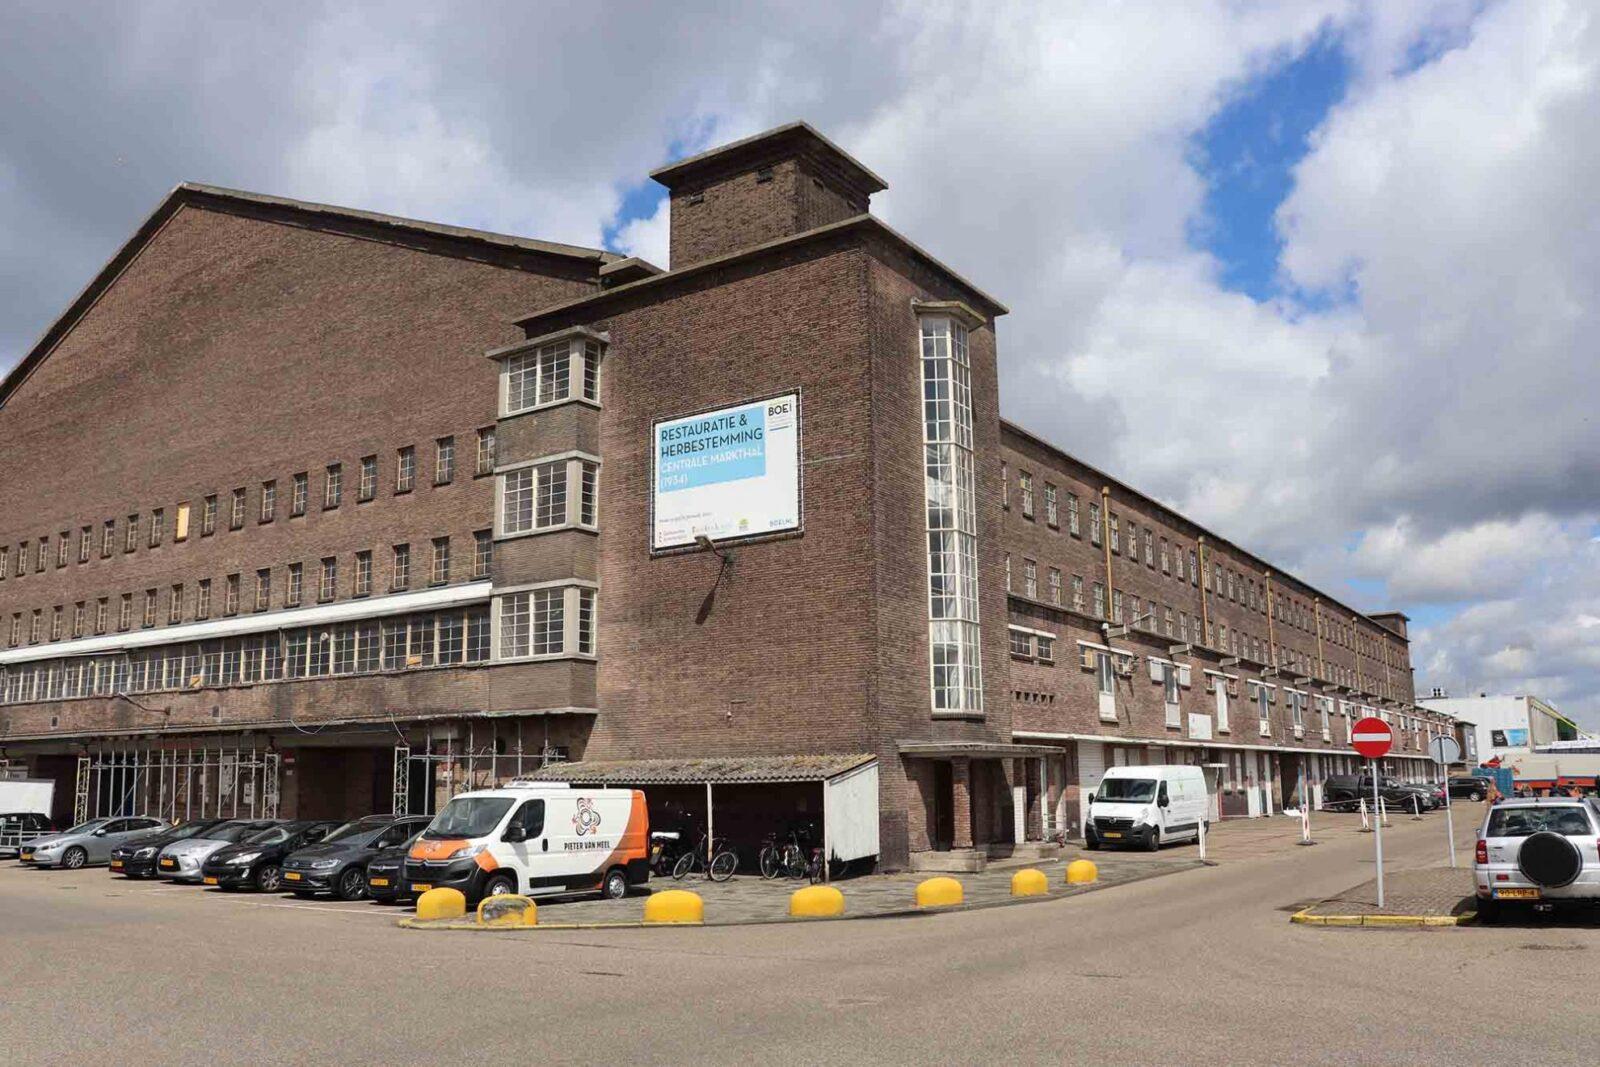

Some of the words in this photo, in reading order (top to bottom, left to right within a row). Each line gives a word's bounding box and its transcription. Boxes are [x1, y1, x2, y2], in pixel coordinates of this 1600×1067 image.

[661, 416, 736, 442] RESTAURATIE
[739, 414, 748, 426] &
[661, 428, 763, 458] HERBESTEMMING
[661, 455, 708, 473] CENTRALE
[710, 447, 763, 464] MARKTHAL
[564, 842, 583, 850] PIETER
[584, 841, 596, 849] VAN
[597, 840, 610, 849] MEEL
